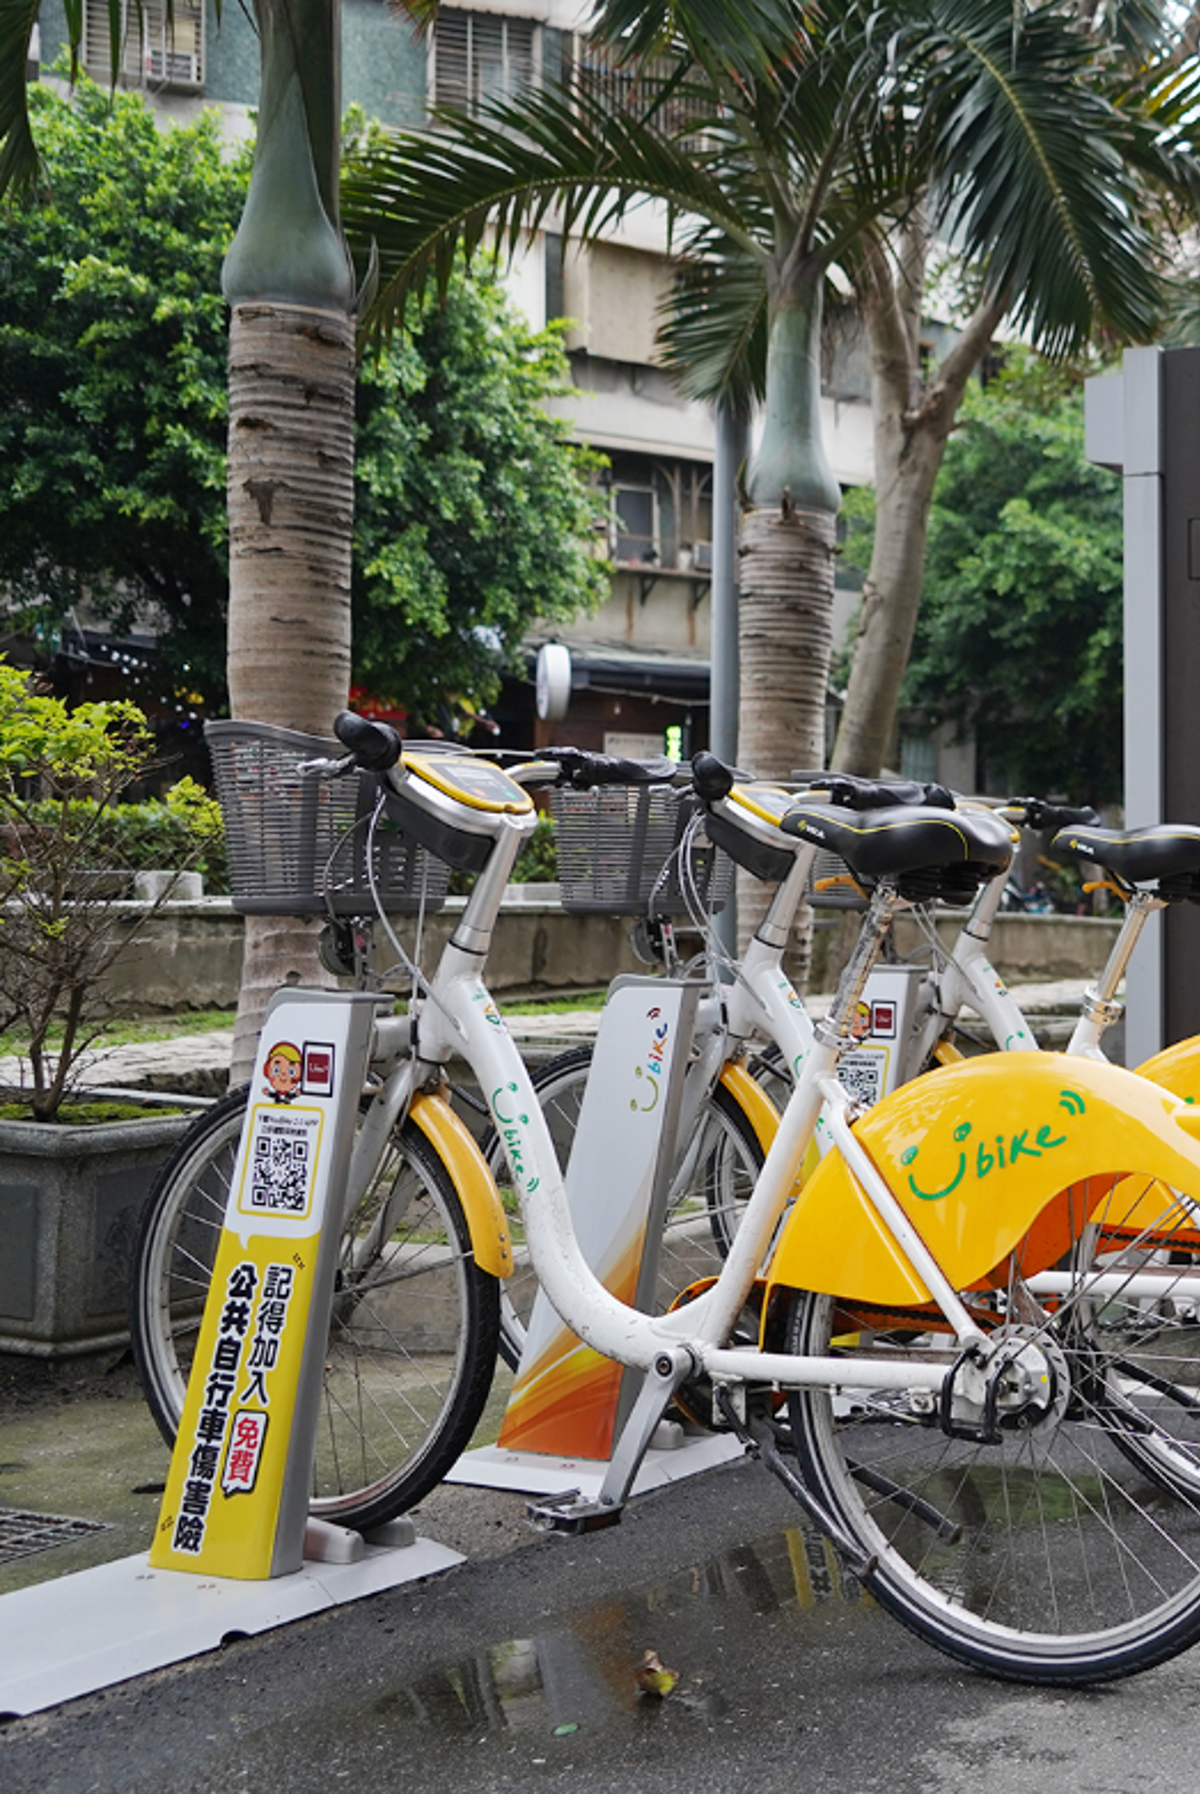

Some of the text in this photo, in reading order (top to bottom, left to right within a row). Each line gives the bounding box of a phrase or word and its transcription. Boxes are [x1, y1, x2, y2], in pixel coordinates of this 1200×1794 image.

[173, 1264, 257, 1553] 公共自行車傷害險
